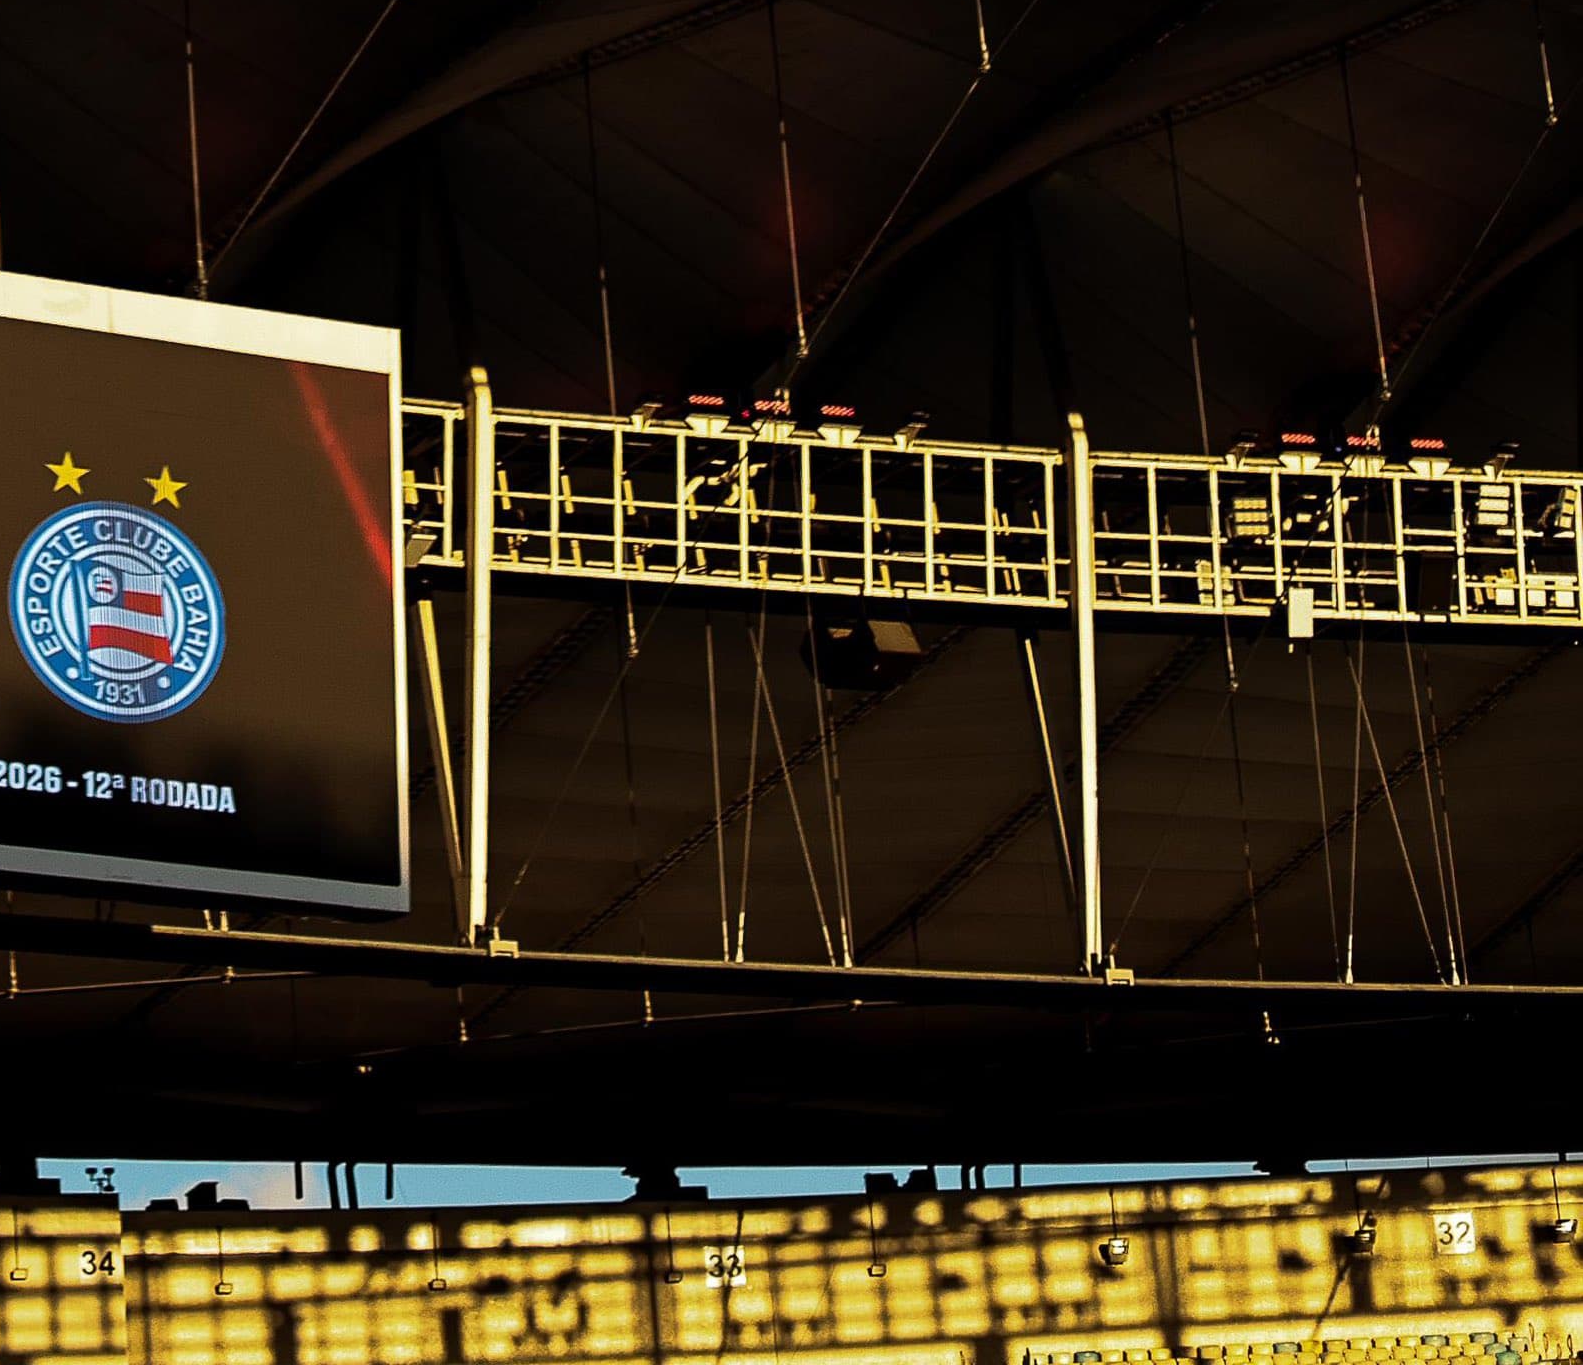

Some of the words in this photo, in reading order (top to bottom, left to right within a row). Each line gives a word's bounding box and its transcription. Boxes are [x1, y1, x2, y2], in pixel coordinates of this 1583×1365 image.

[27, 524, 88, 658] ESPORTE
[93, 519, 191, 579] CLUBE
[173, 582, 210, 674] BAHIA
[94, 680, 146, 705] 1931
[130, 775, 237, 814] RODADA
[1438, 1221, 1471, 1245] 32
[81, 1250, 116, 1276] 34
